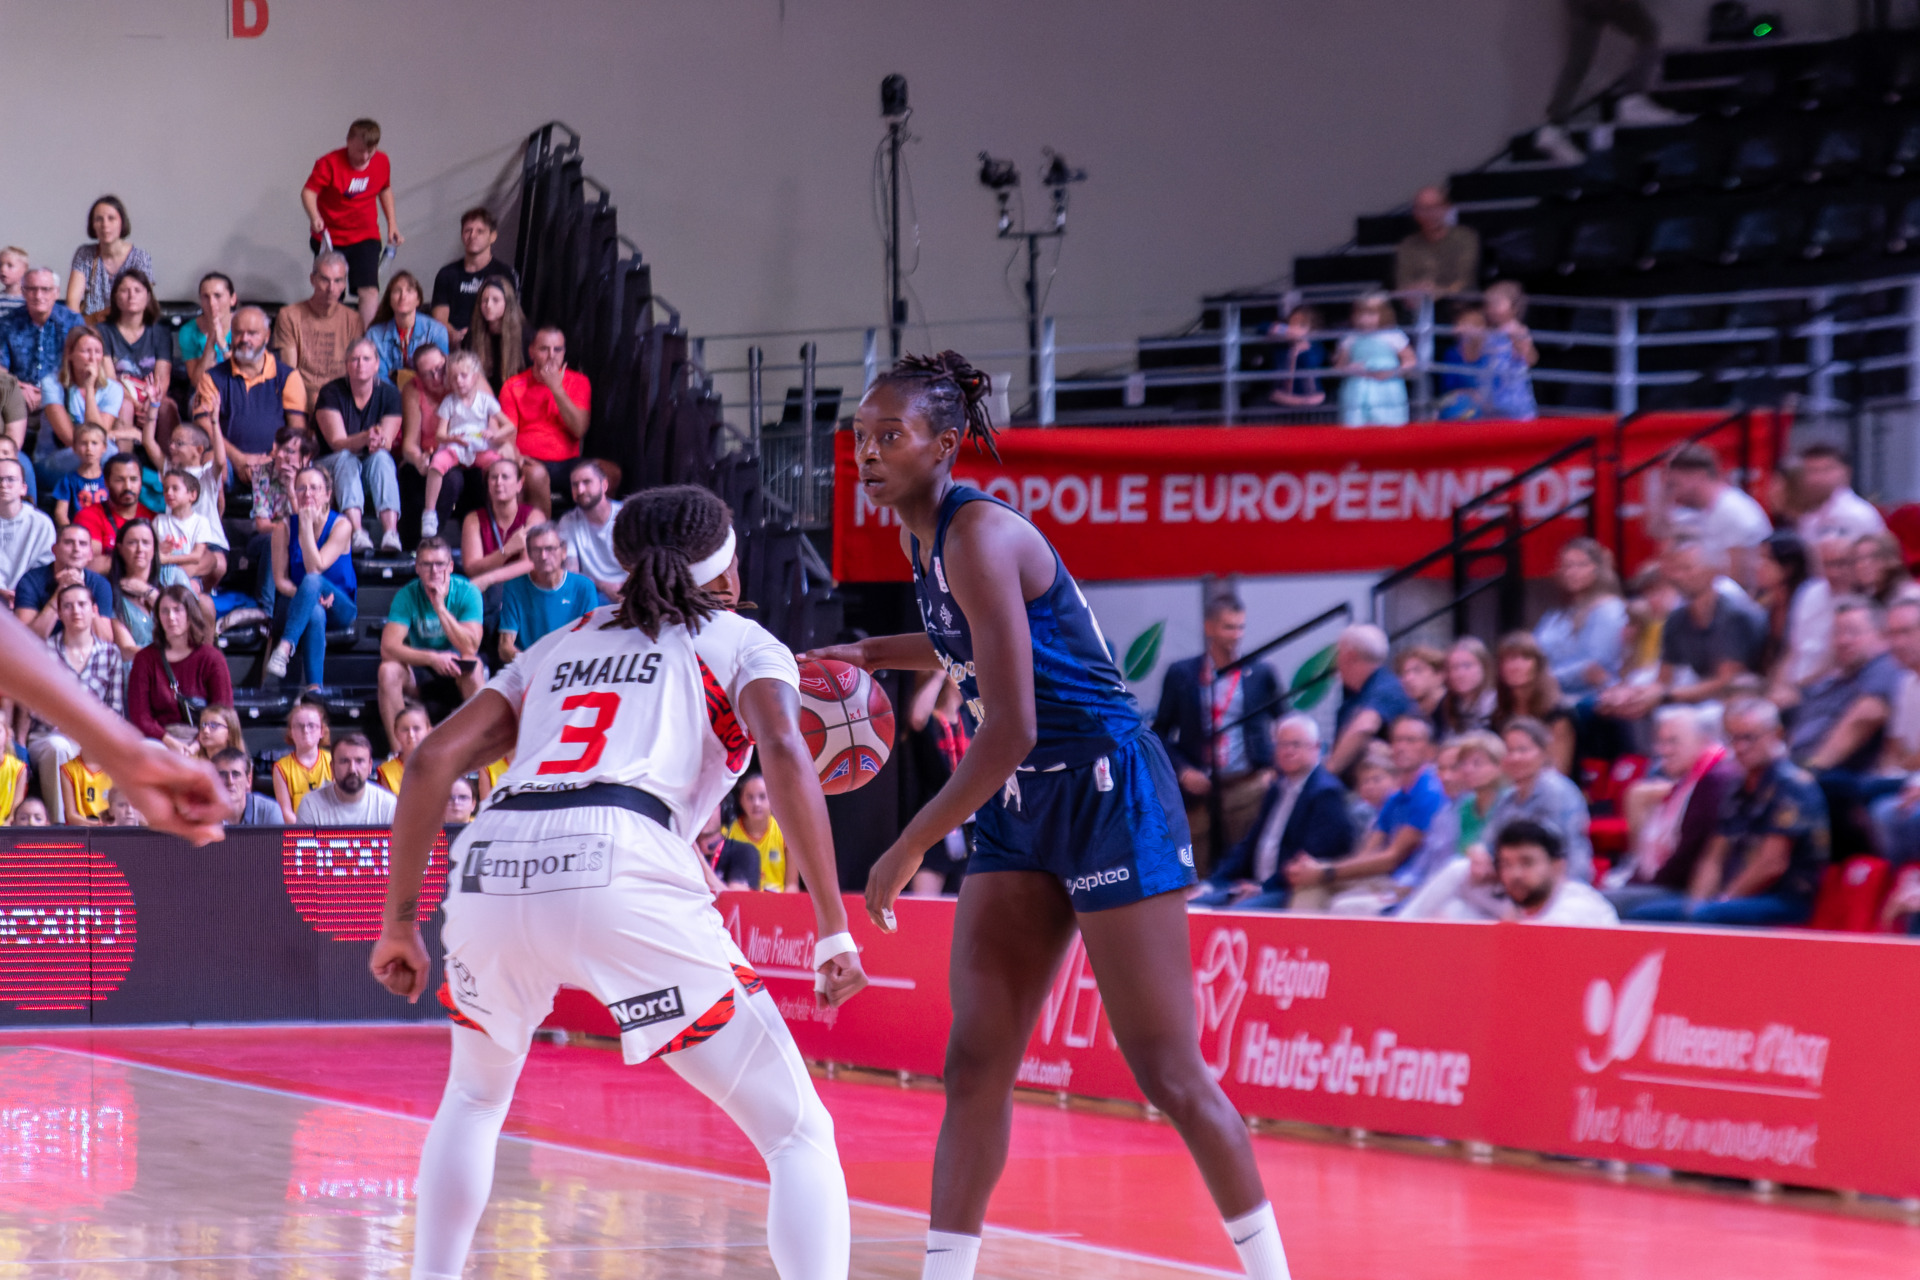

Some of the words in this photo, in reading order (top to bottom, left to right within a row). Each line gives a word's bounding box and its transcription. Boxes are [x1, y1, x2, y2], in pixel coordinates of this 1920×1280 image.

[855, 474, 1149, 527] MOPOLE
[1161, 461, 1513, 523] EUROPÉENNE
[551, 653, 663, 692] SMALLS
[536, 691, 622, 776] 3
[464, 842, 604, 889] Temporis
[609, 988, 679, 1025] Nord
[1255, 946, 1330, 1010] Région
[1236, 1021, 1471, 1106] Hauts-de-France
